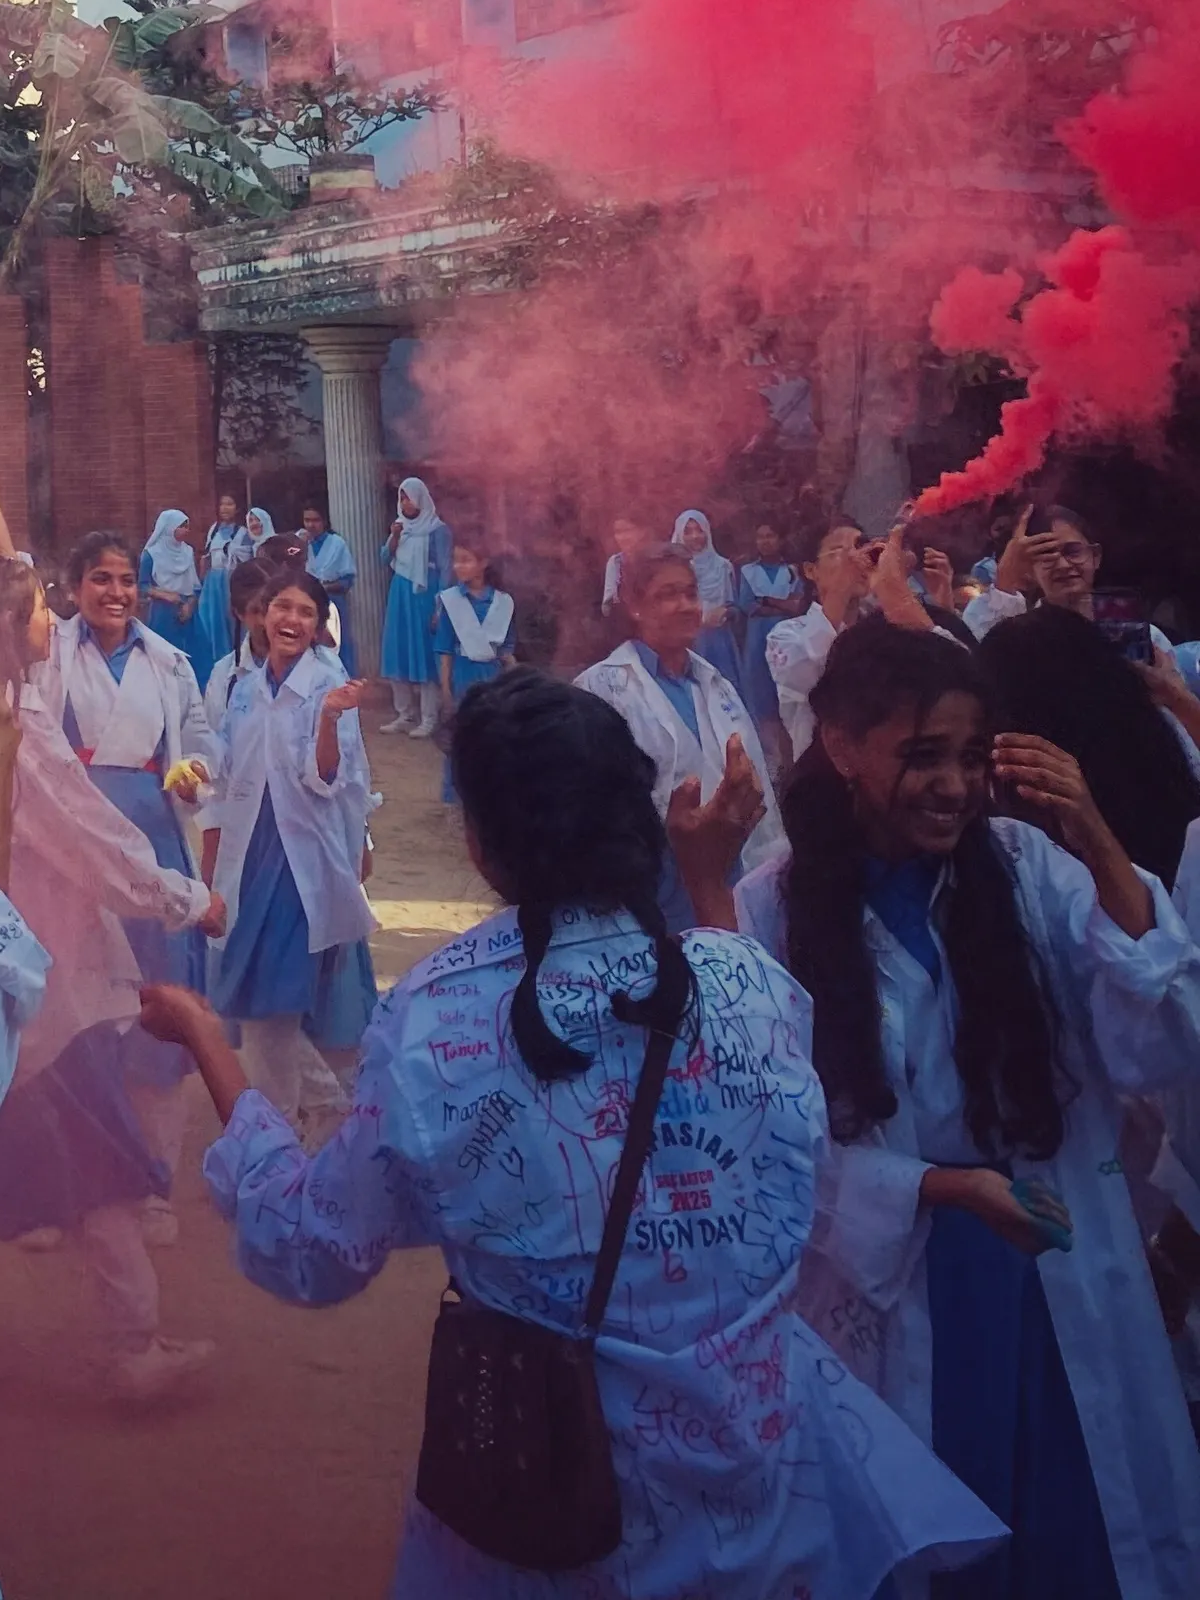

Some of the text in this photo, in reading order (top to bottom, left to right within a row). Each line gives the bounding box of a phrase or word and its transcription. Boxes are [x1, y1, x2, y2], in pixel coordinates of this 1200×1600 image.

[645, 1121, 739, 1172] ASIAN
[634, 1211, 747, 1252] SIGN DAY
